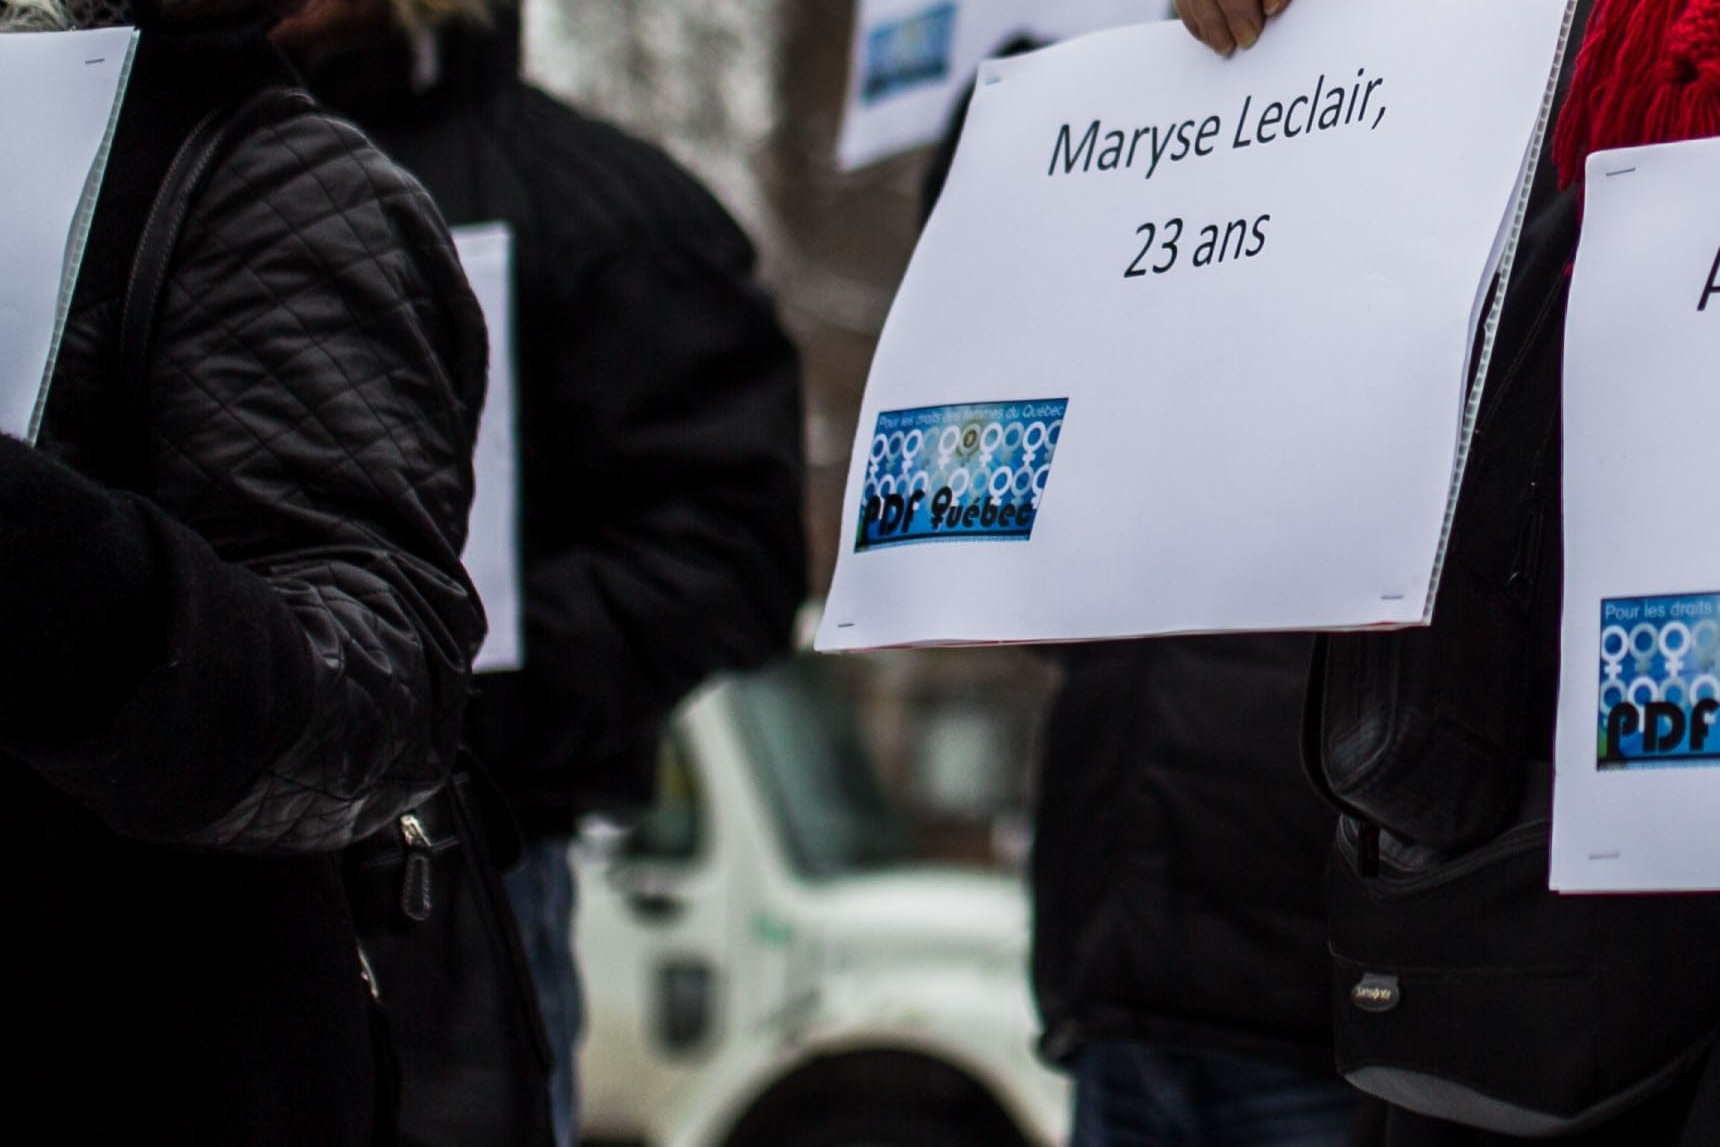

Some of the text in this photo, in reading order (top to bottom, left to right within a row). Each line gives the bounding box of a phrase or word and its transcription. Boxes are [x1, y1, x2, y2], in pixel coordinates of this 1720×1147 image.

[1048, 67, 1386, 180] Maryse Leclair,
[1123, 214, 1271, 279] 23 ans
[866, 486, 1036, 537] PDF Québec
[1605, 602, 1639, 621] Pour
[1644, 599, 1666, 619] les
[1670, 597, 1712, 617] droits
[1607, 698, 1720, 755] PDF
